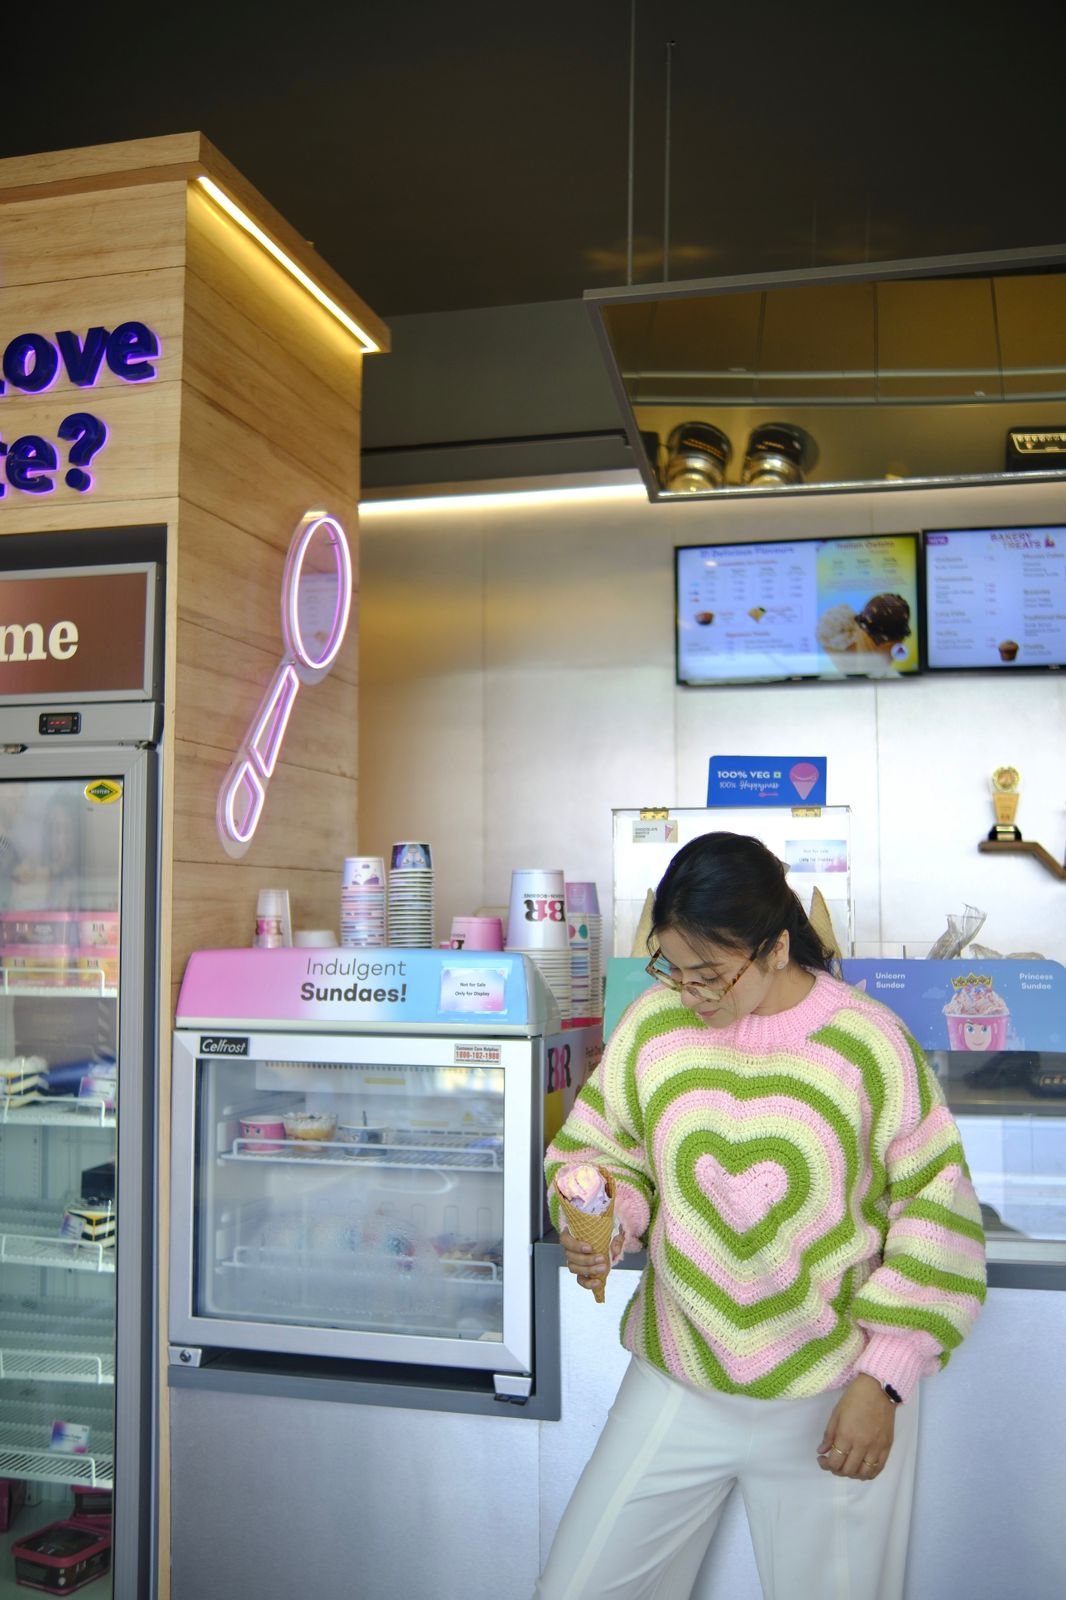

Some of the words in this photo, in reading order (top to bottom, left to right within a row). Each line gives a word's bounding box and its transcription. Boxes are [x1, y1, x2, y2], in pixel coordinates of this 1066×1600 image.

[0, 321, 161, 395] ove
[0, 412, 108, 495] e?
[717, 771, 748, 779] 100%
[750, 771, 770, 779] VEG
[306, 957, 407, 981] Indulgent
[875, 972, 906, 980] Unicorn
[1019, 972, 1053, 981] Princess
[875, 981, 906, 989] Sundae
[1021, 981, 1052, 990] Sundae
[300, 982, 407, 1003] Sundaes!
[202, 1038, 246, 1053] Celfrost
